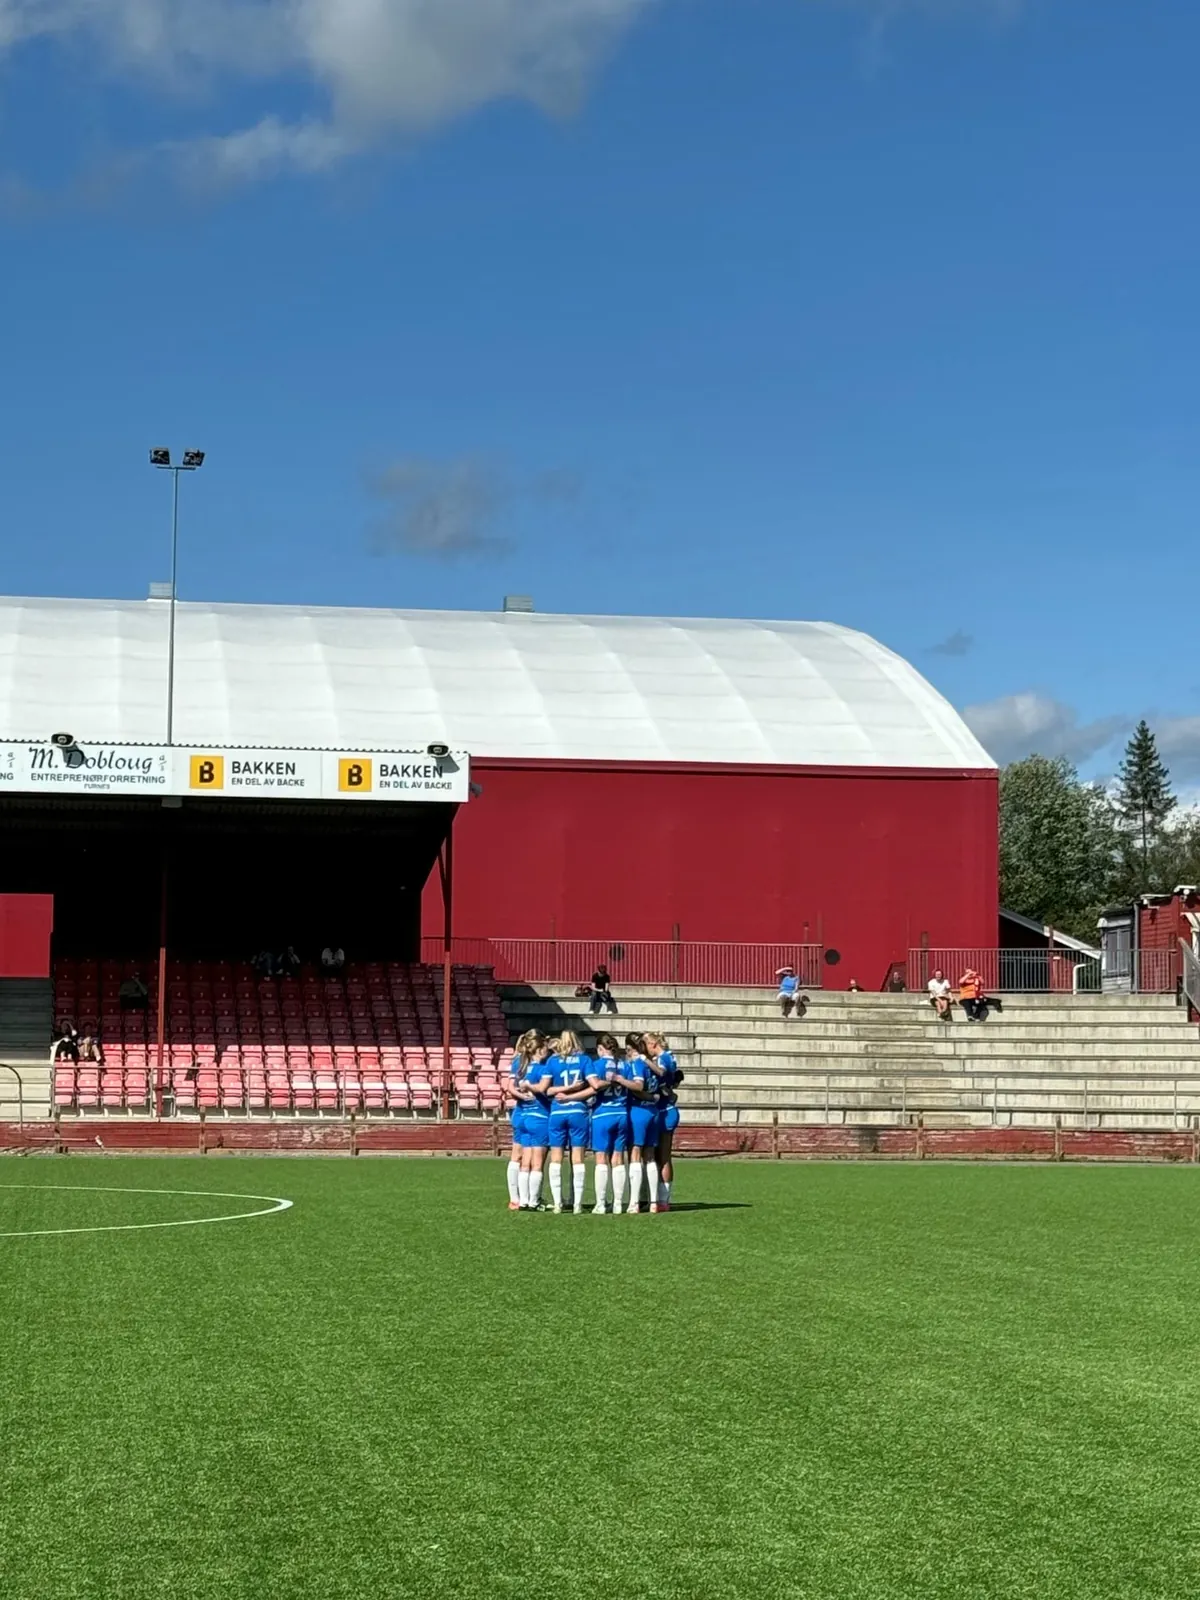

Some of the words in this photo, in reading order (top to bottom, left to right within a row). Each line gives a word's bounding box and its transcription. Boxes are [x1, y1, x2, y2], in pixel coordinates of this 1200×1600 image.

[28, 747, 58, 769] M.
[66, 749, 153, 774] Dobloug
[199, 761, 215, 783] B
[231, 761, 296, 775] BAKKEN
[347, 764, 363, 786] B
[379, 764, 443, 778] BAKKEN
[31, 773, 166, 784] ENTREPRENØRFORRETNING
[231, 777, 243, 786] EN
[245, 778, 261, 786] DEL
[263, 778, 275, 786] AV
[277, 778, 305, 787] BACKE
[379, 780, 390, 788] EN
[393, 781, 409, 789] DEL
[411, 781, 423, 789] AV
[425, 782, 452, 790] BACKE
[560, 1069, 580, 1088] 17
